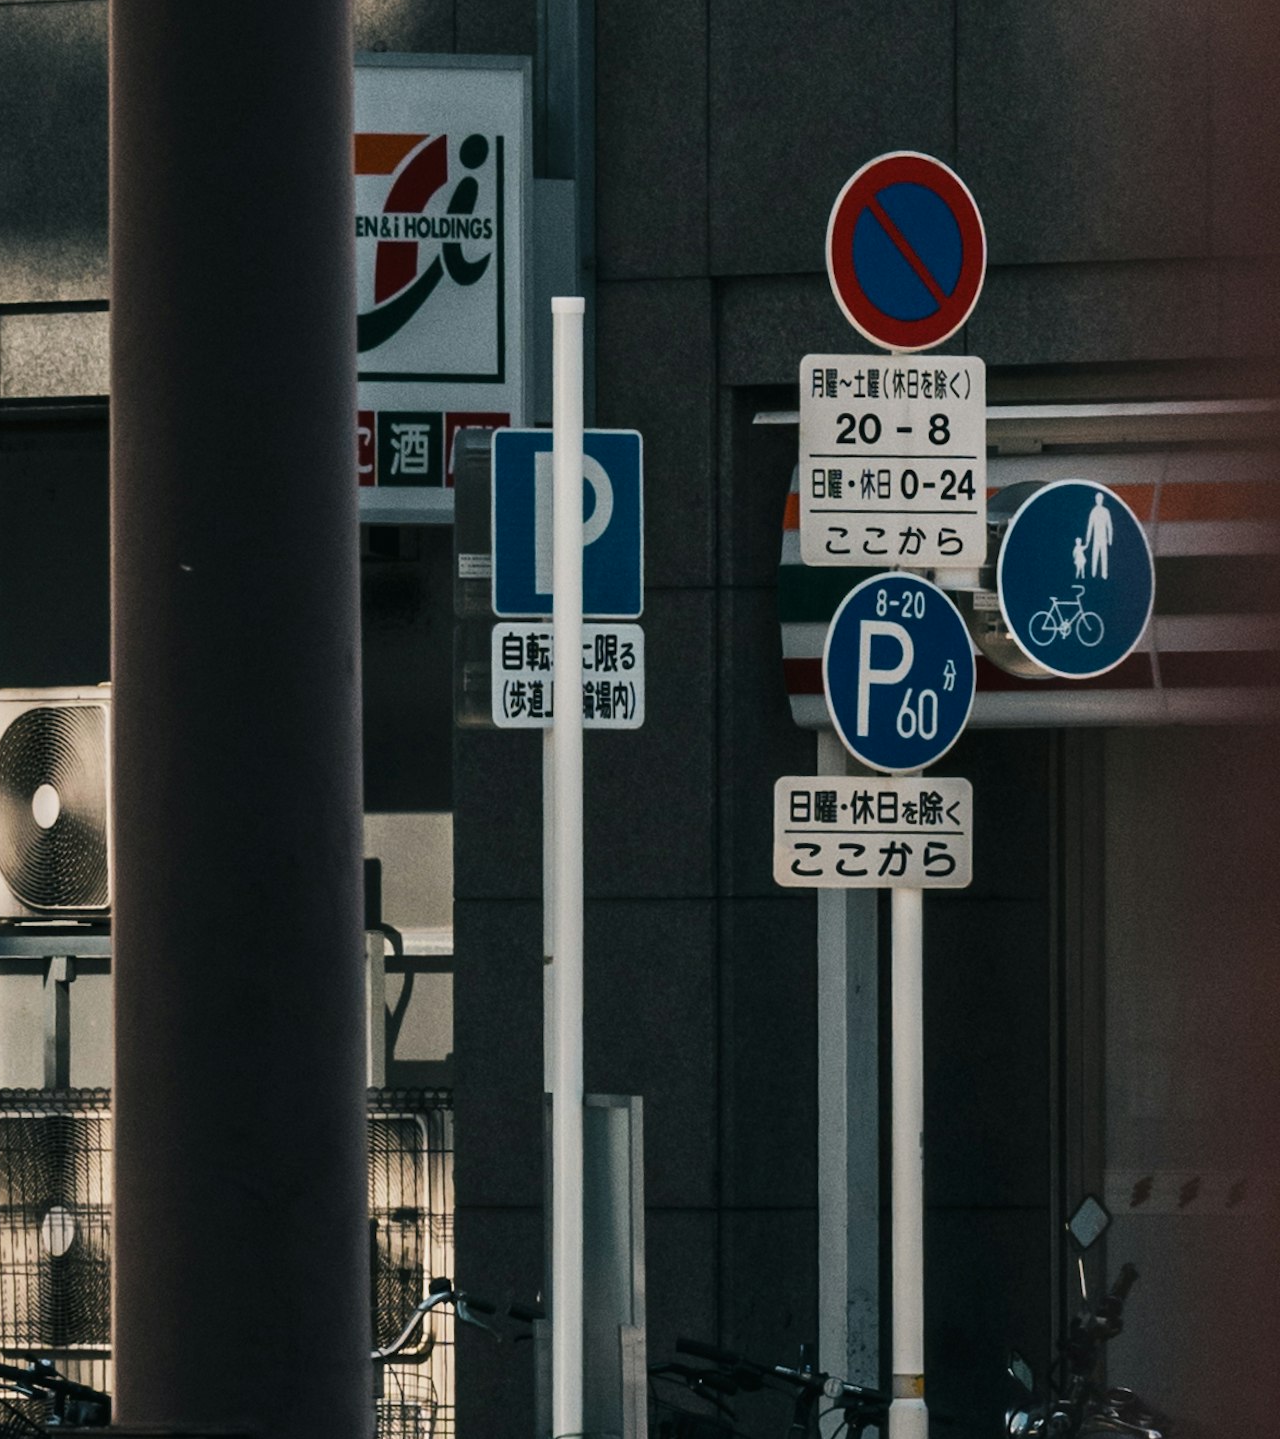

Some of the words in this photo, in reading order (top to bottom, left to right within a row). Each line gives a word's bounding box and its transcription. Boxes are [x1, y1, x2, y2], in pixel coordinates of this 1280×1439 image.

[355, 216, 399, 238] EN&i
[404, 216, 493, 239] HOLDINGS
[390, 423, 431, 475] 酒
[901, 470, 976, 501] 0-24
[534, 451, 615, 595] P
[825, 526, 964, 555] ここから
[876, 588, 926, 619] 8-20
[502, 632, 636, 672] 自転に限る
[856, 619, 915, 738] P
[896, 686, 939, 741] 60
[791, 840, 957, 877] ここから
